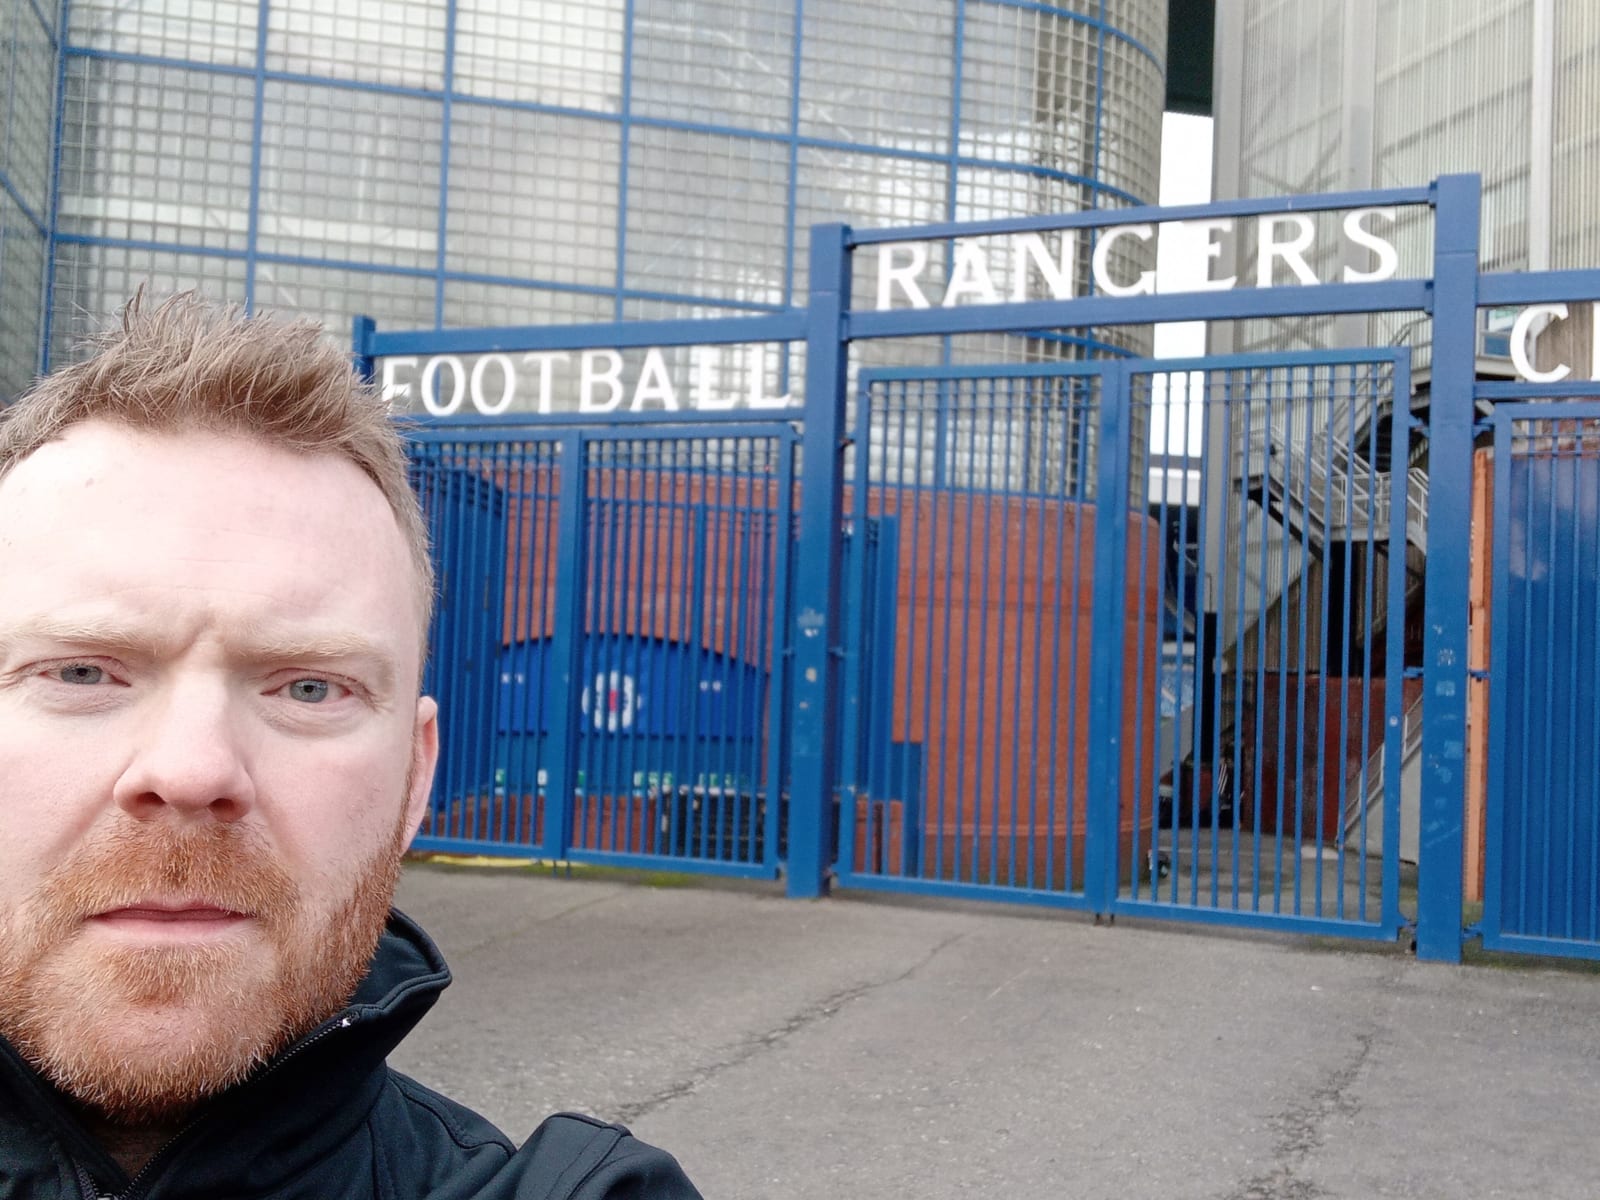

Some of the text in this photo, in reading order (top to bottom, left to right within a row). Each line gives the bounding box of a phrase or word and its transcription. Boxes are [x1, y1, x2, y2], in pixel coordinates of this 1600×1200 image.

[876, 208, 1399, 312] RANGERS
[381, 344, 791, 417] FOOTBALL
[1510, 302, 1600, 383] C
